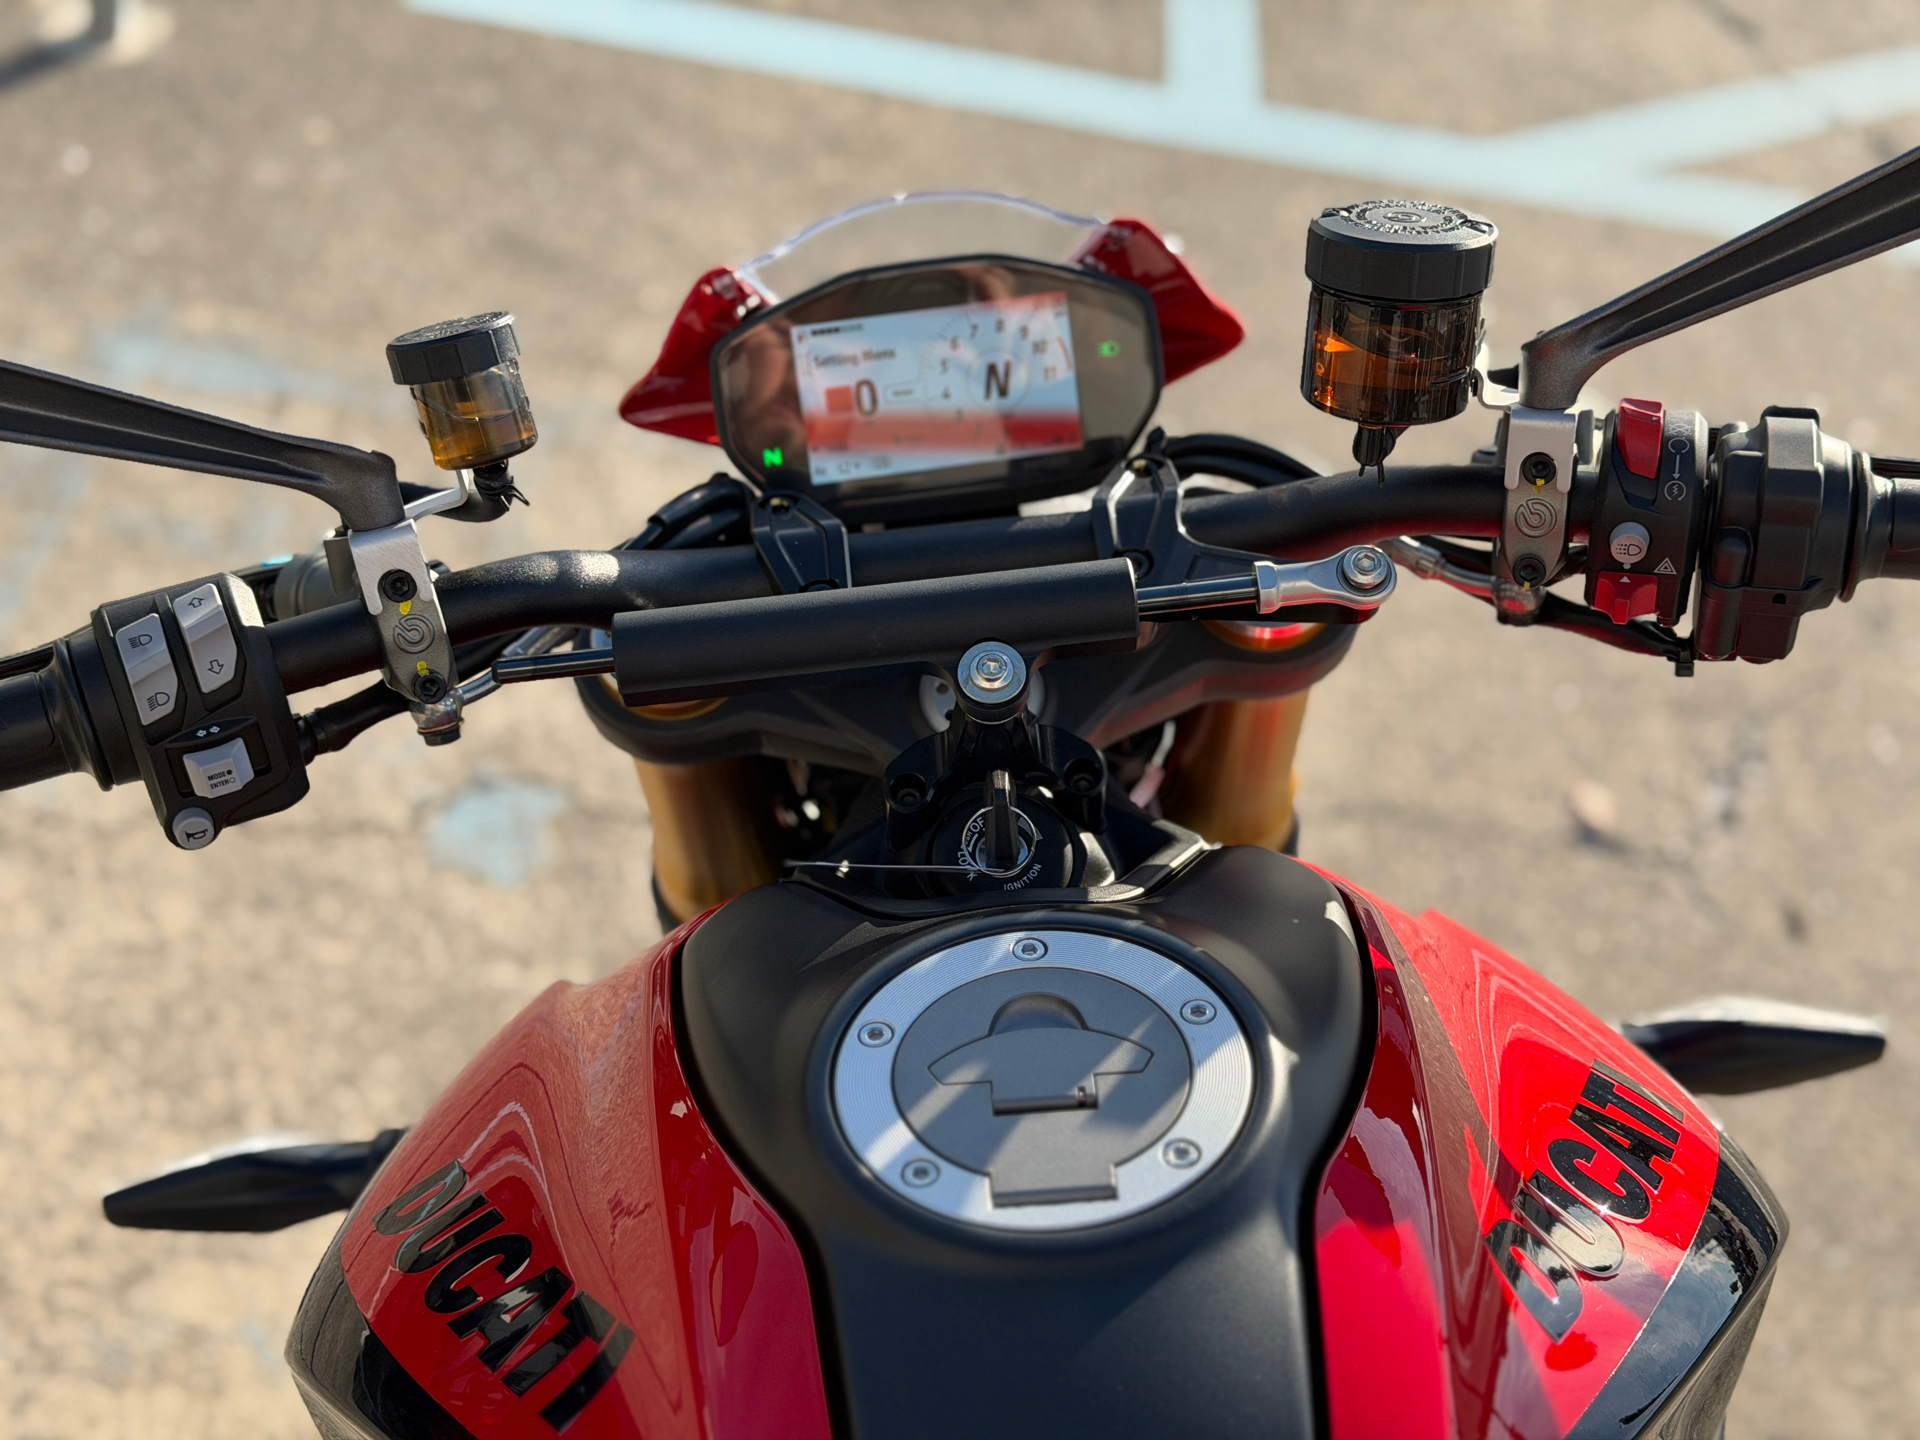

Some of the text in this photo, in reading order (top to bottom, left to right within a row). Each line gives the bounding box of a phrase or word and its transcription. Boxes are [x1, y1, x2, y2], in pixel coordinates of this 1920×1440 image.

[985, 360, 1011, 400] N
[855, 379, 878, 416] 0
[763, 447, 783, 468] N
[207, 770, 227, 781] MODE
[210, 779, 230, 790] ENTER
[969, 816, 985, 832] OF
[957, 851, 978, 882] LOK
[1003, 863, 1043, 891] IGNITION
[1484, 1058, 1685, 1345] DUCATI
[371, 1158, 637, 1436] DUCATI
